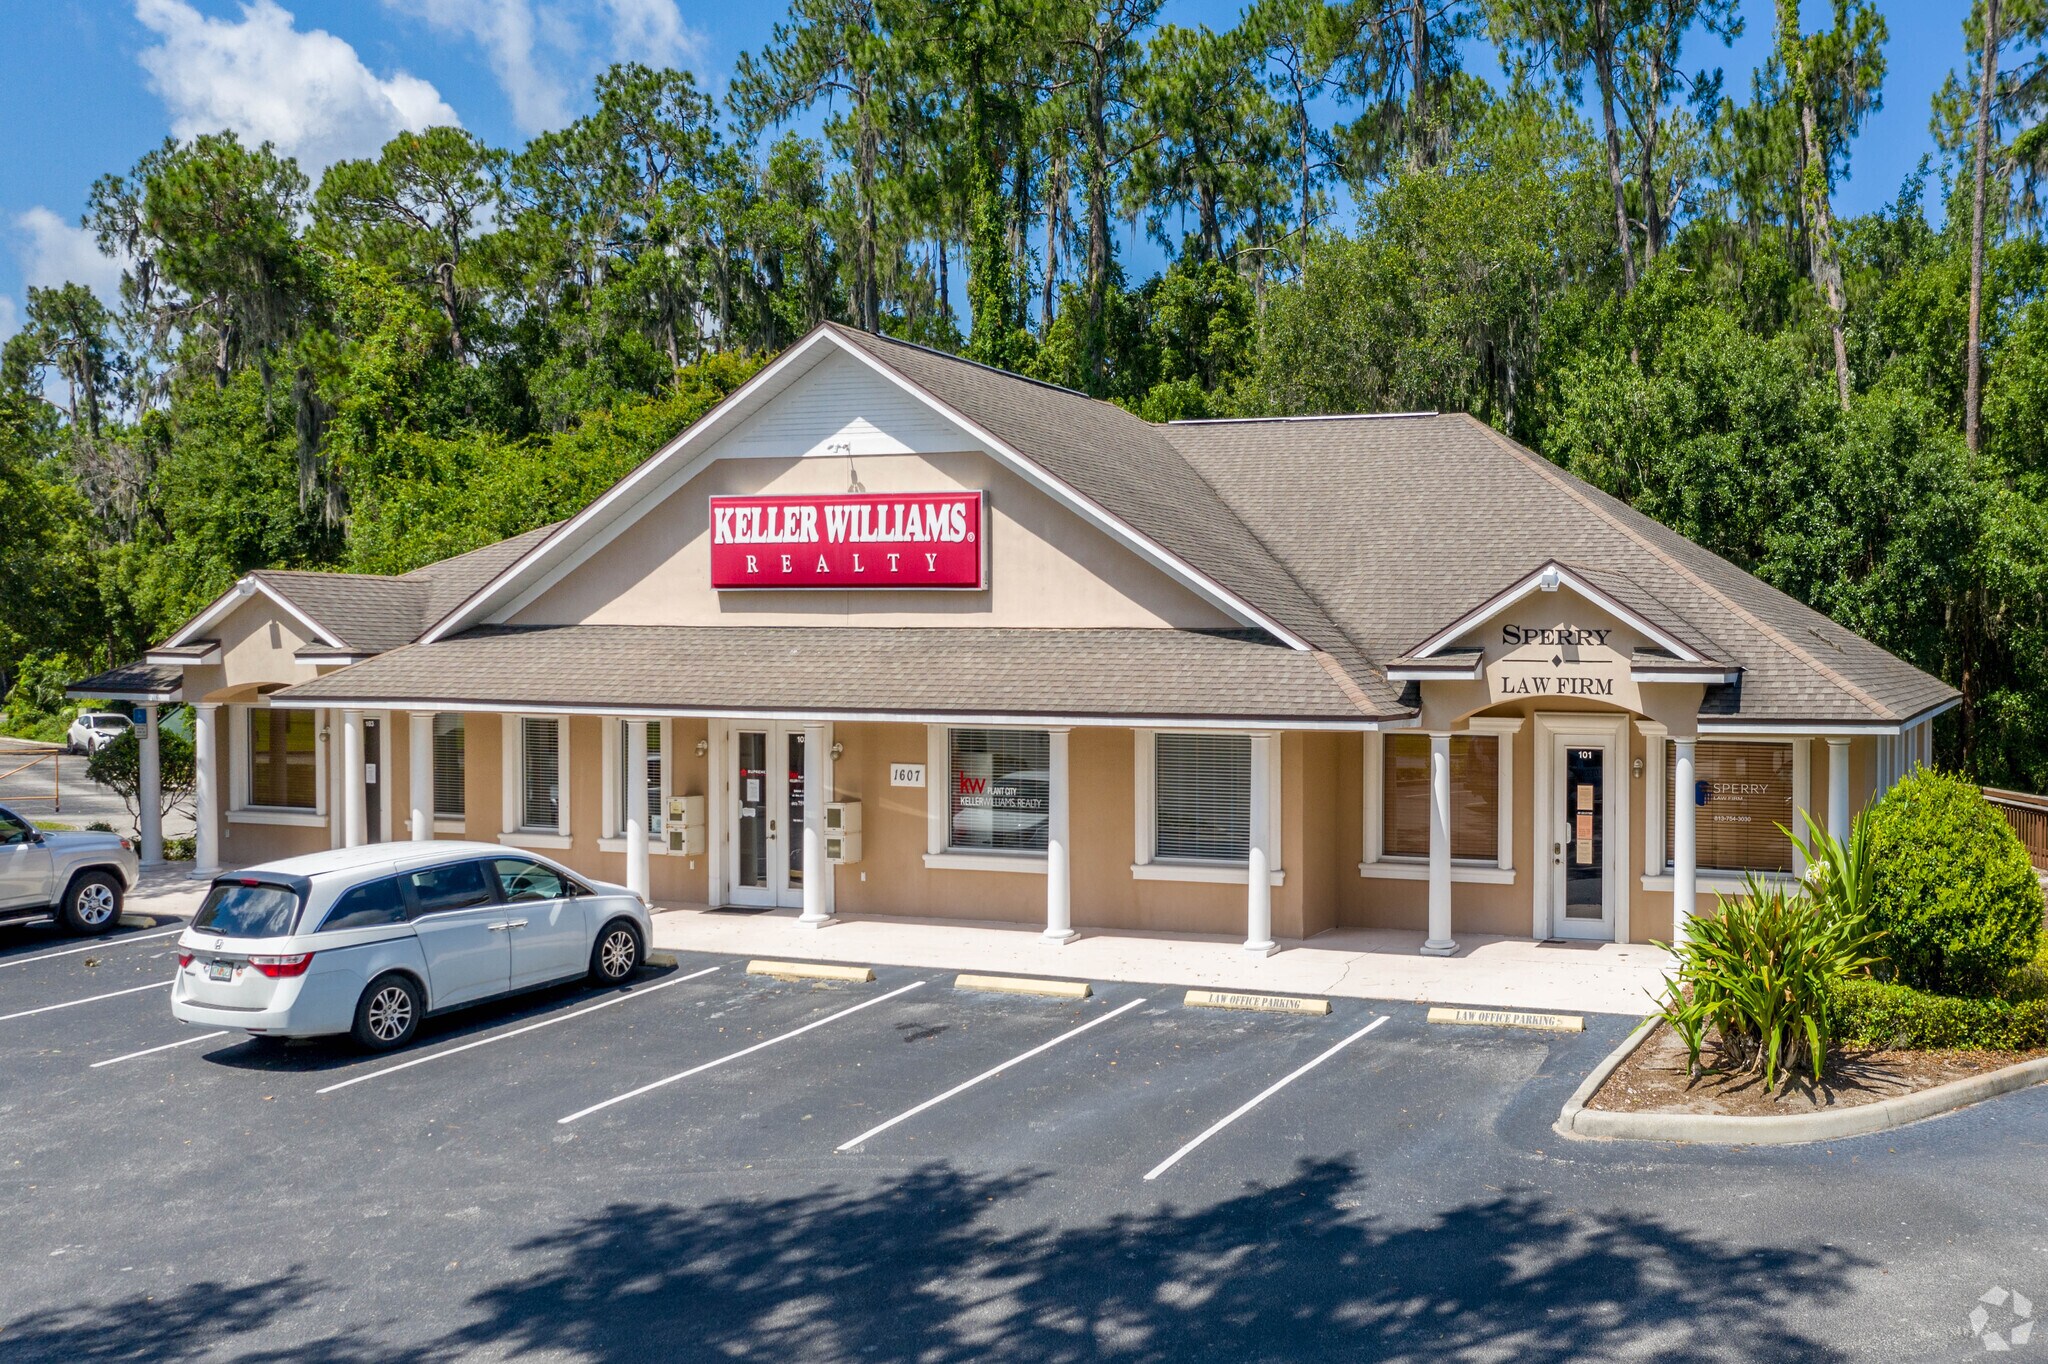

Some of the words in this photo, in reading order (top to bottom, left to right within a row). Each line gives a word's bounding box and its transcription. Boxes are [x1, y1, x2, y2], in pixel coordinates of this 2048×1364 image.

[714, 505, 820, 545] KELLER
[746, 553, 938, 574] REALTY
[1502, 624, 1612, 646] SPERRY
[1501, 676, 1551, 694] LAW
[1556, 677, 1614, 695] FIRM
[1578, 751, 1592, 759] 101
[894, 769, 921, 782] 1607
[987, 787, 1005, 795] PLANT
[1005, 787, 1017, 796] CITY
[1713, 783, 1769, 794] SPERRY
[1018, 798, 1042, 808] REALTY
[1208, 993, 1227, 1003] LAW
[1229, 995, 1260, 1006] OFFICE
[1261, 997, 1301, 1009] PARKING
[1455, 1011, 1477, 1021] LAW
[1478, 1012, 1511, 1023] OFFICE
[1513, 1014, 1555, 1026] PARKING
